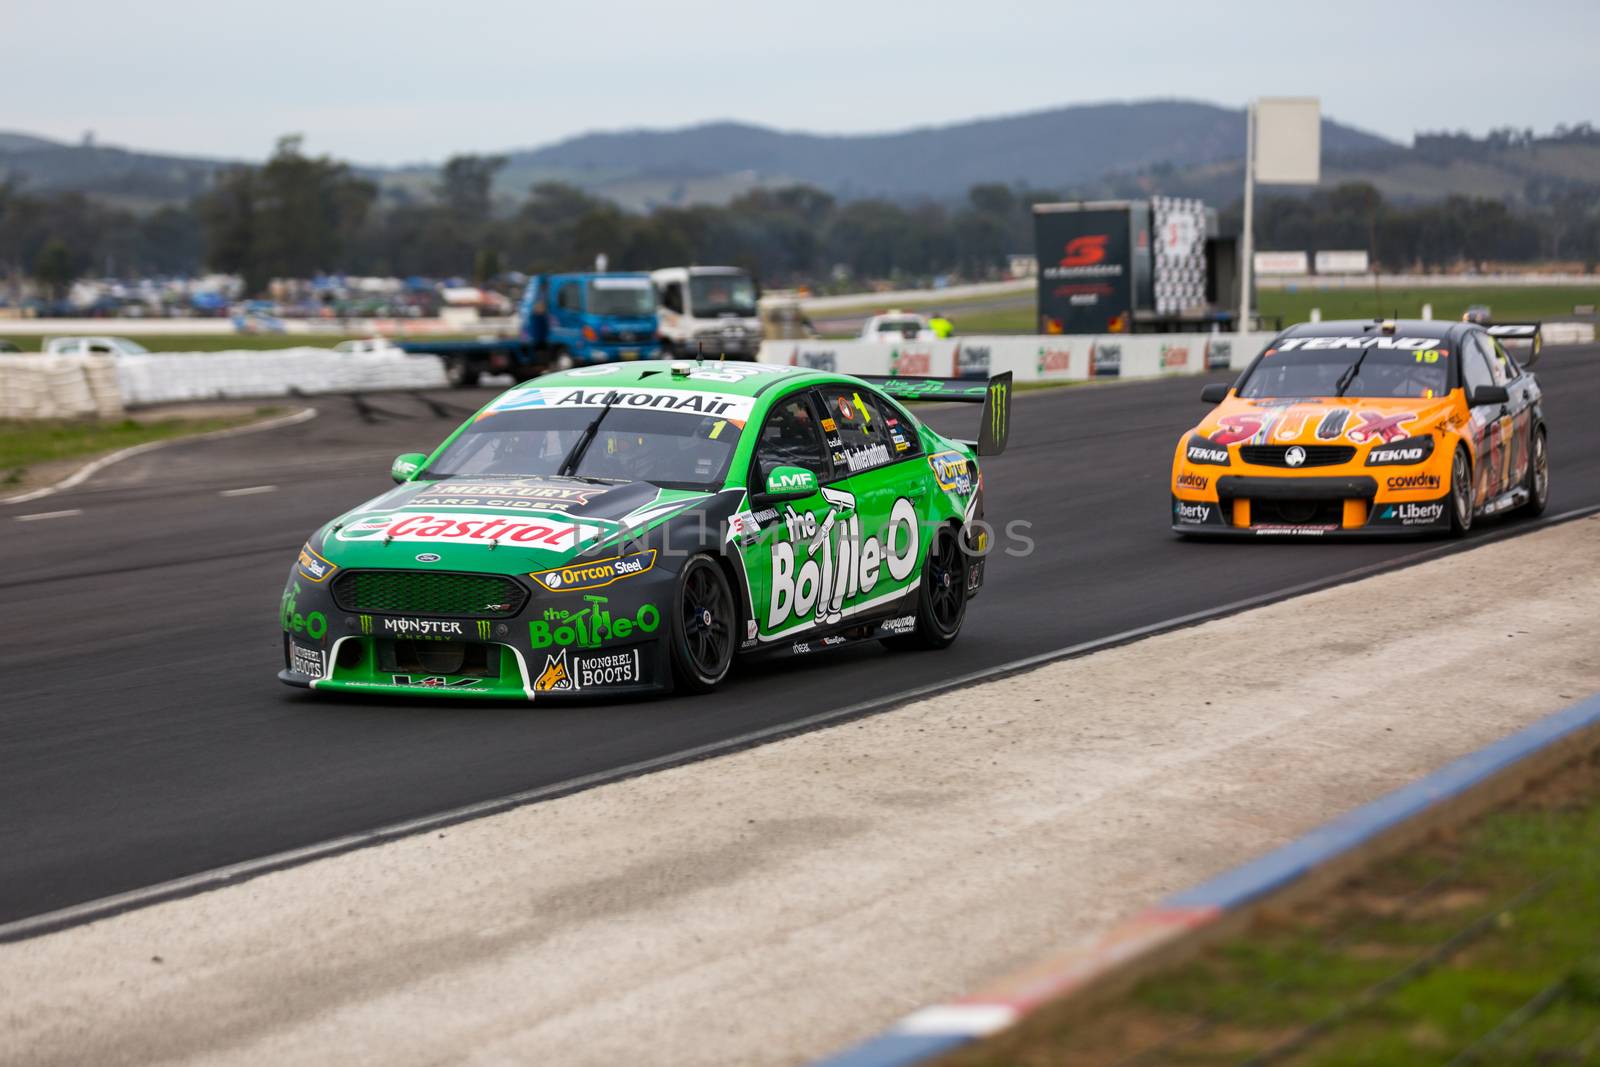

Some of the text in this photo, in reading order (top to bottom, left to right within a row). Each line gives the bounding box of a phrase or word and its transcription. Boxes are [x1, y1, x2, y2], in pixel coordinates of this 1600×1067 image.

[1278, 337, 1440, 351] TEKNO
[1411, 350, 1438, 363] 19
[555, 389, 737, 415] ActronAir
[708, 420, 727, 440] 1
[1187, 446, 1228, 463] TEKNO
[1369, 448, 1423, 463] TEKNO
[769, 473, 812, 488] LMF
[1387, 472, 1440, 489] cowdroy
[438, 484, 578, 499] MERCURY
[487, 499, 570, 511] CIDER
[1399, 503, 1443, 520] Liberty
[386, 516, 577, 545] Castrol
[784, 505, 817, 543] the
[562, 558, 643, 584] Orrcon Steel
[543, 607, 570, 621] the
[384, 618, 463, 634] MONSTER
[582, 653, 632, 670] MONGREL
[582, 665, 632, 686] BOOTS
